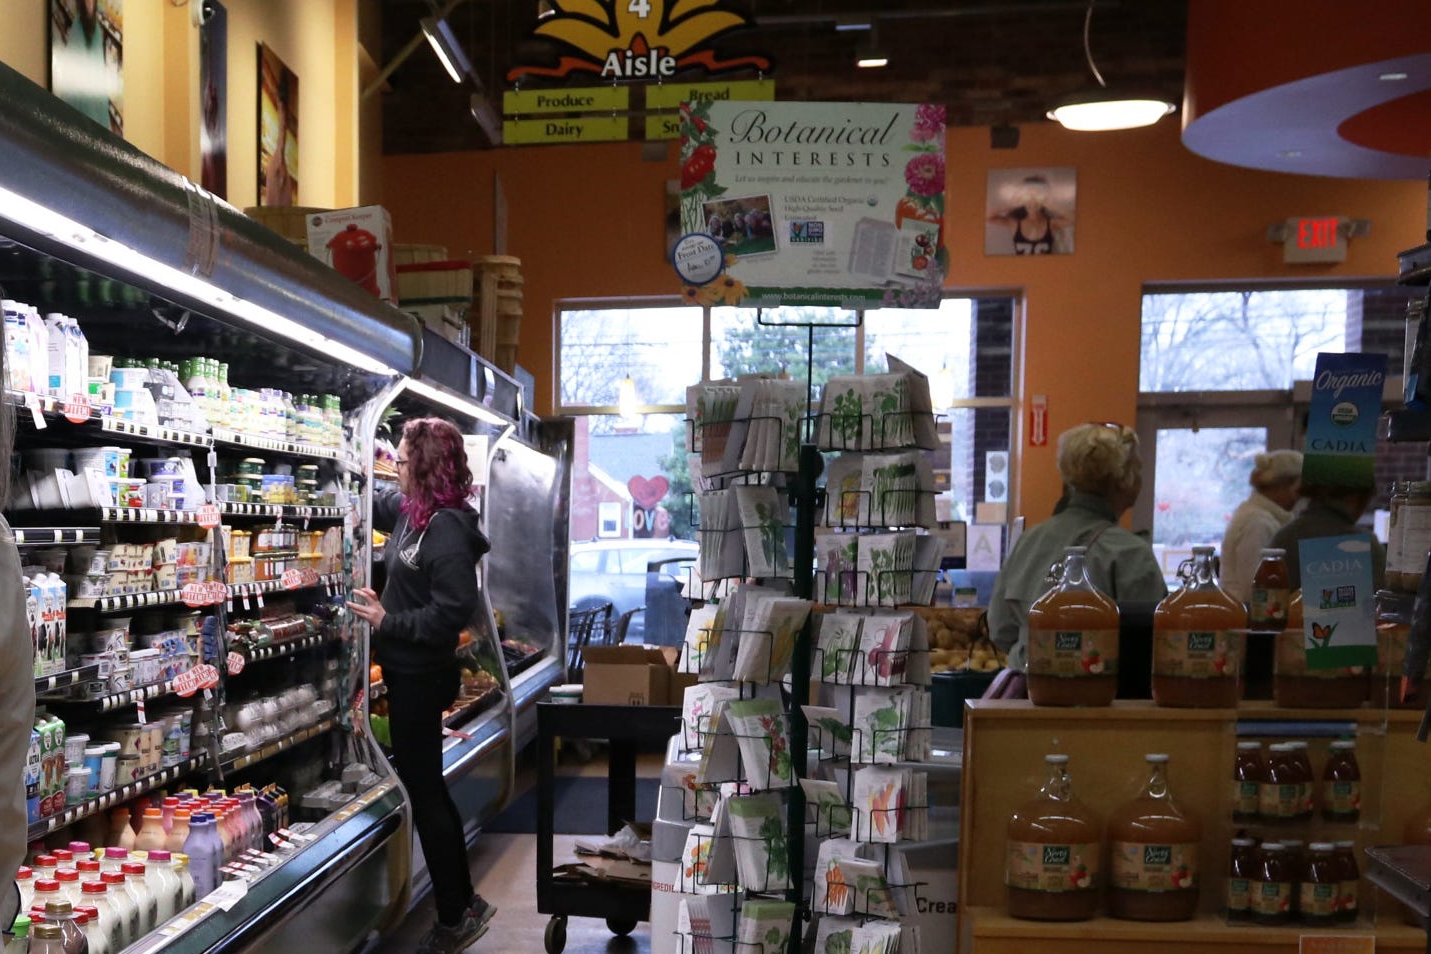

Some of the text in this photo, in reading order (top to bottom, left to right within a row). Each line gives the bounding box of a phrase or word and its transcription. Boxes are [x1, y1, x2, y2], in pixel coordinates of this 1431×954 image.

[628, 0, 651, 19] 4
[601, 49, 676, 77] Aisle
[537, 95, 594, 108] Produce
[689, 88, 730, 101] Bread
[545, 123, 584, 138] Dairy
[730, 109, 900, 145] Botanical
[736, 151, 890, 167] INTERESTS
[1297, 218, 1340, 249] EXIT
[696, 244, 714, 254] Date
[1316, 369, 1384, 399] Organic
[1311, 438, 1367, 453] CADIA
[1306, 558, 1363, 574] CADIA
[189, 585, 203, 593] NEW
[178, 673, 192, 682] NEW
[917, 897, 957, 915] Crea
